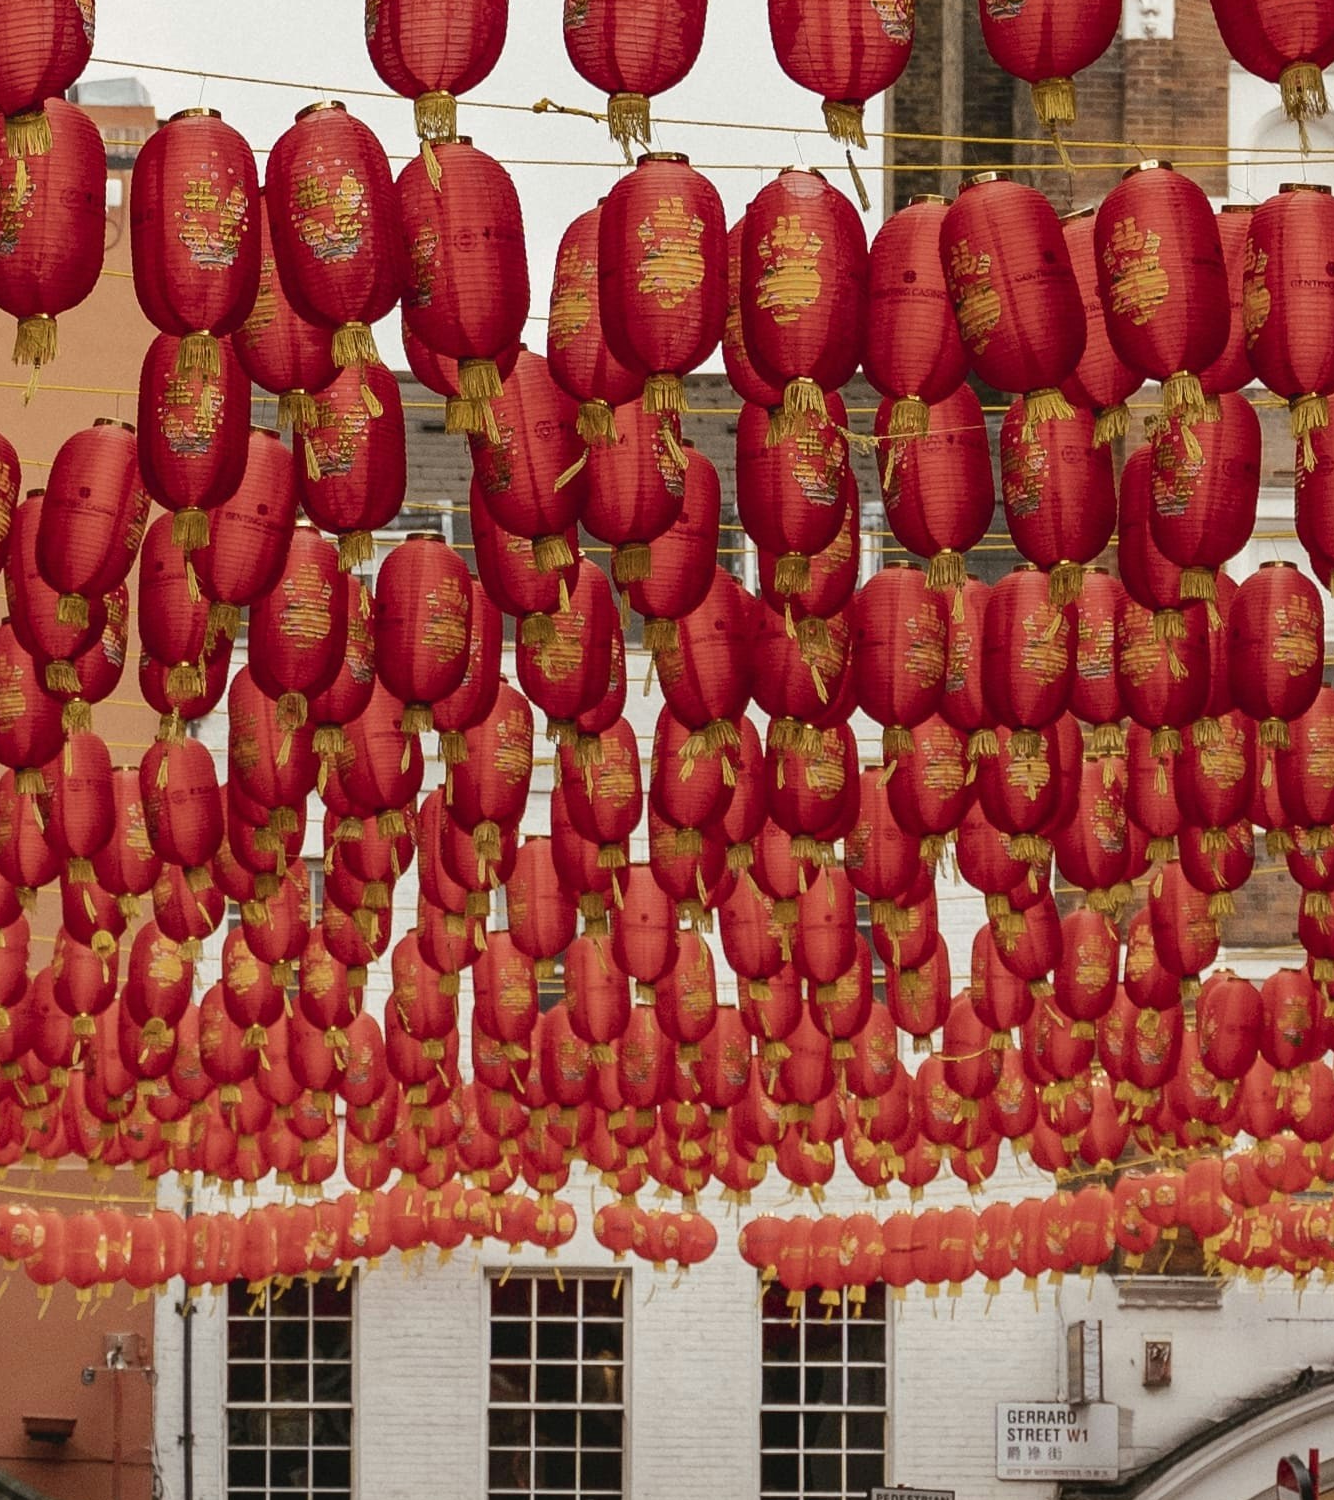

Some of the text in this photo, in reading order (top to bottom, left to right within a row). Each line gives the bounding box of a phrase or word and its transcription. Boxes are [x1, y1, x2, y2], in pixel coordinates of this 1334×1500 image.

[1007, 1409, 1077, 1425] GERRARD
[1007, 1428, 1088, 1443] STREET W1
